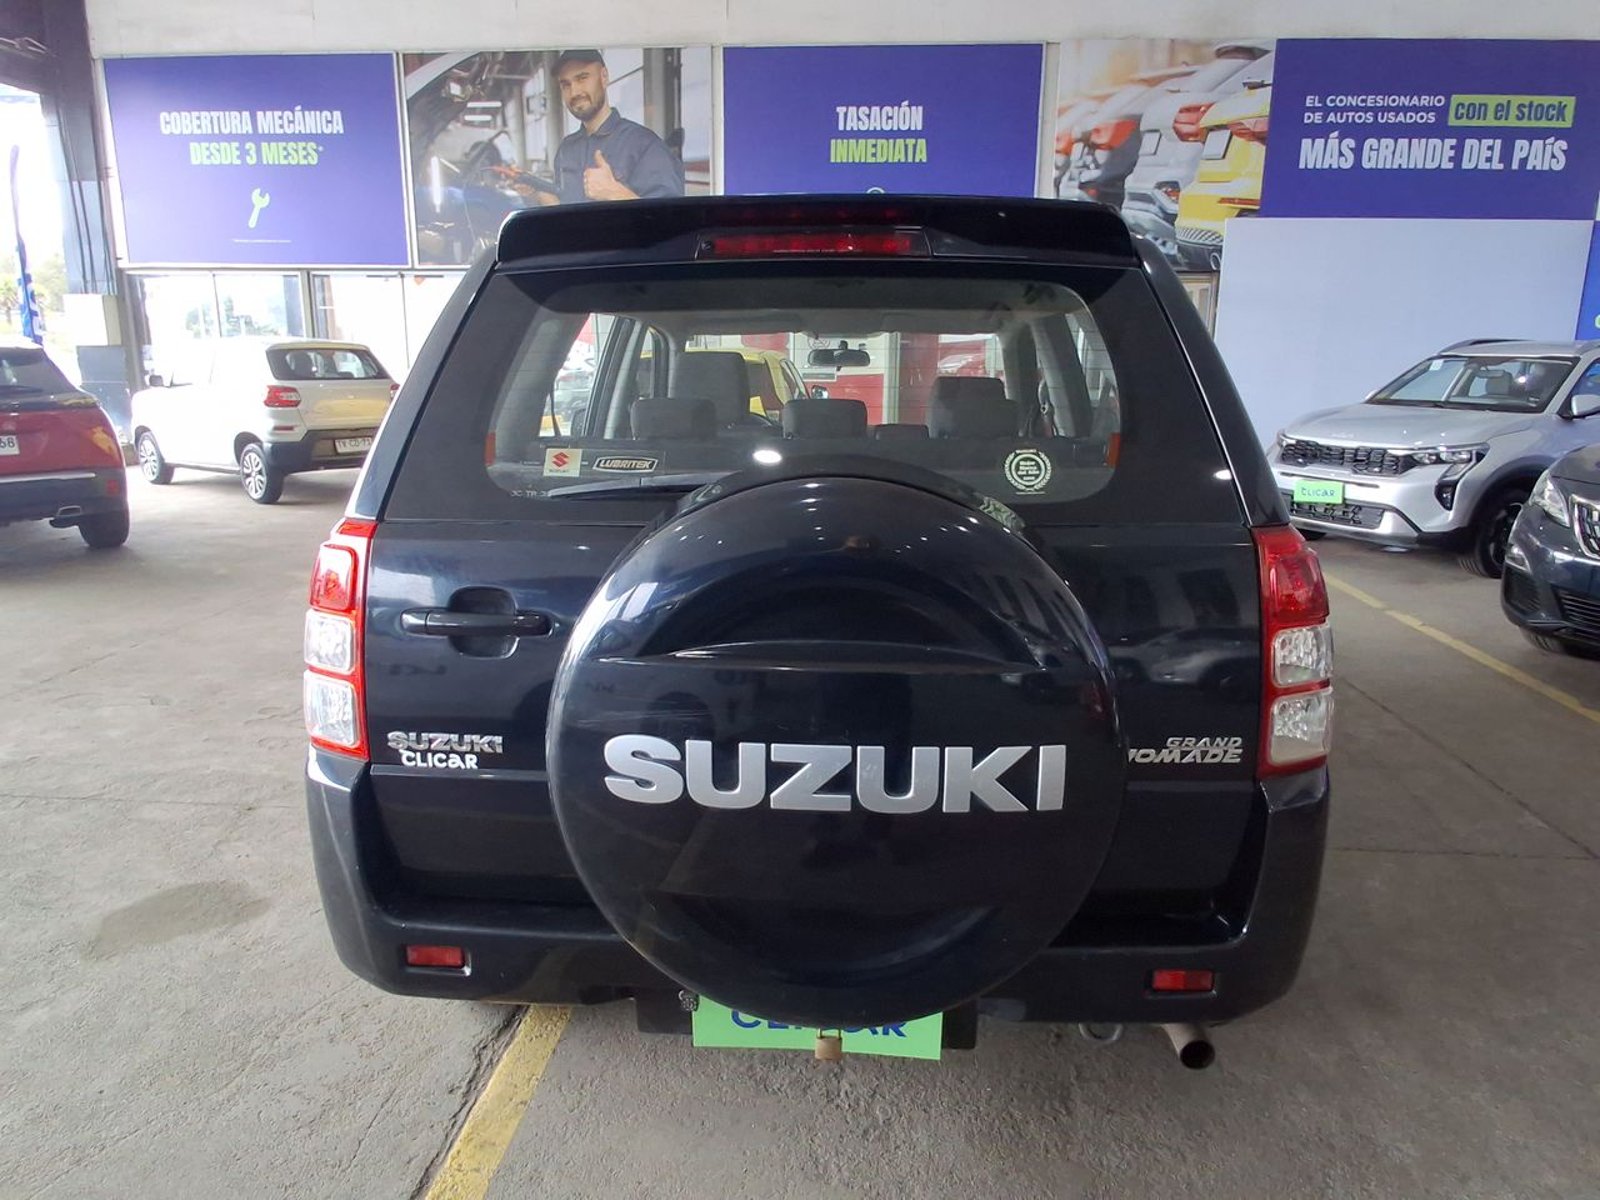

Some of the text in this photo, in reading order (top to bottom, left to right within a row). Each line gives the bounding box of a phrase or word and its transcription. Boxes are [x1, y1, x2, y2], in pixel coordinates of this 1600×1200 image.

[1305, 95, 1445, 108] EL CONCESIONARIO
[1454, 99, 1568, 122] con el stock
[159, 105, 344, 135] COBERTURA MECÁNICA
[836, 100, 924, 131] TASACIÓN
[1304, 112, 1436, 123] DE AUTOS USADOS
[189, 141, 241, 165] DESDE
[245, 142, 257, 165] 3
[830, 138, 927, 163] INMEDIATA
[1299, 130, 1568, 171] MÁS GRANDE DEL PAÍS
[599, 458, 652, 470] LUBRITEK
[387, 731, 503, 753] SUZUKI
[1166, 737, 1242, 748] GRAND
[603, 734, 1067, 814] SUZUKI
